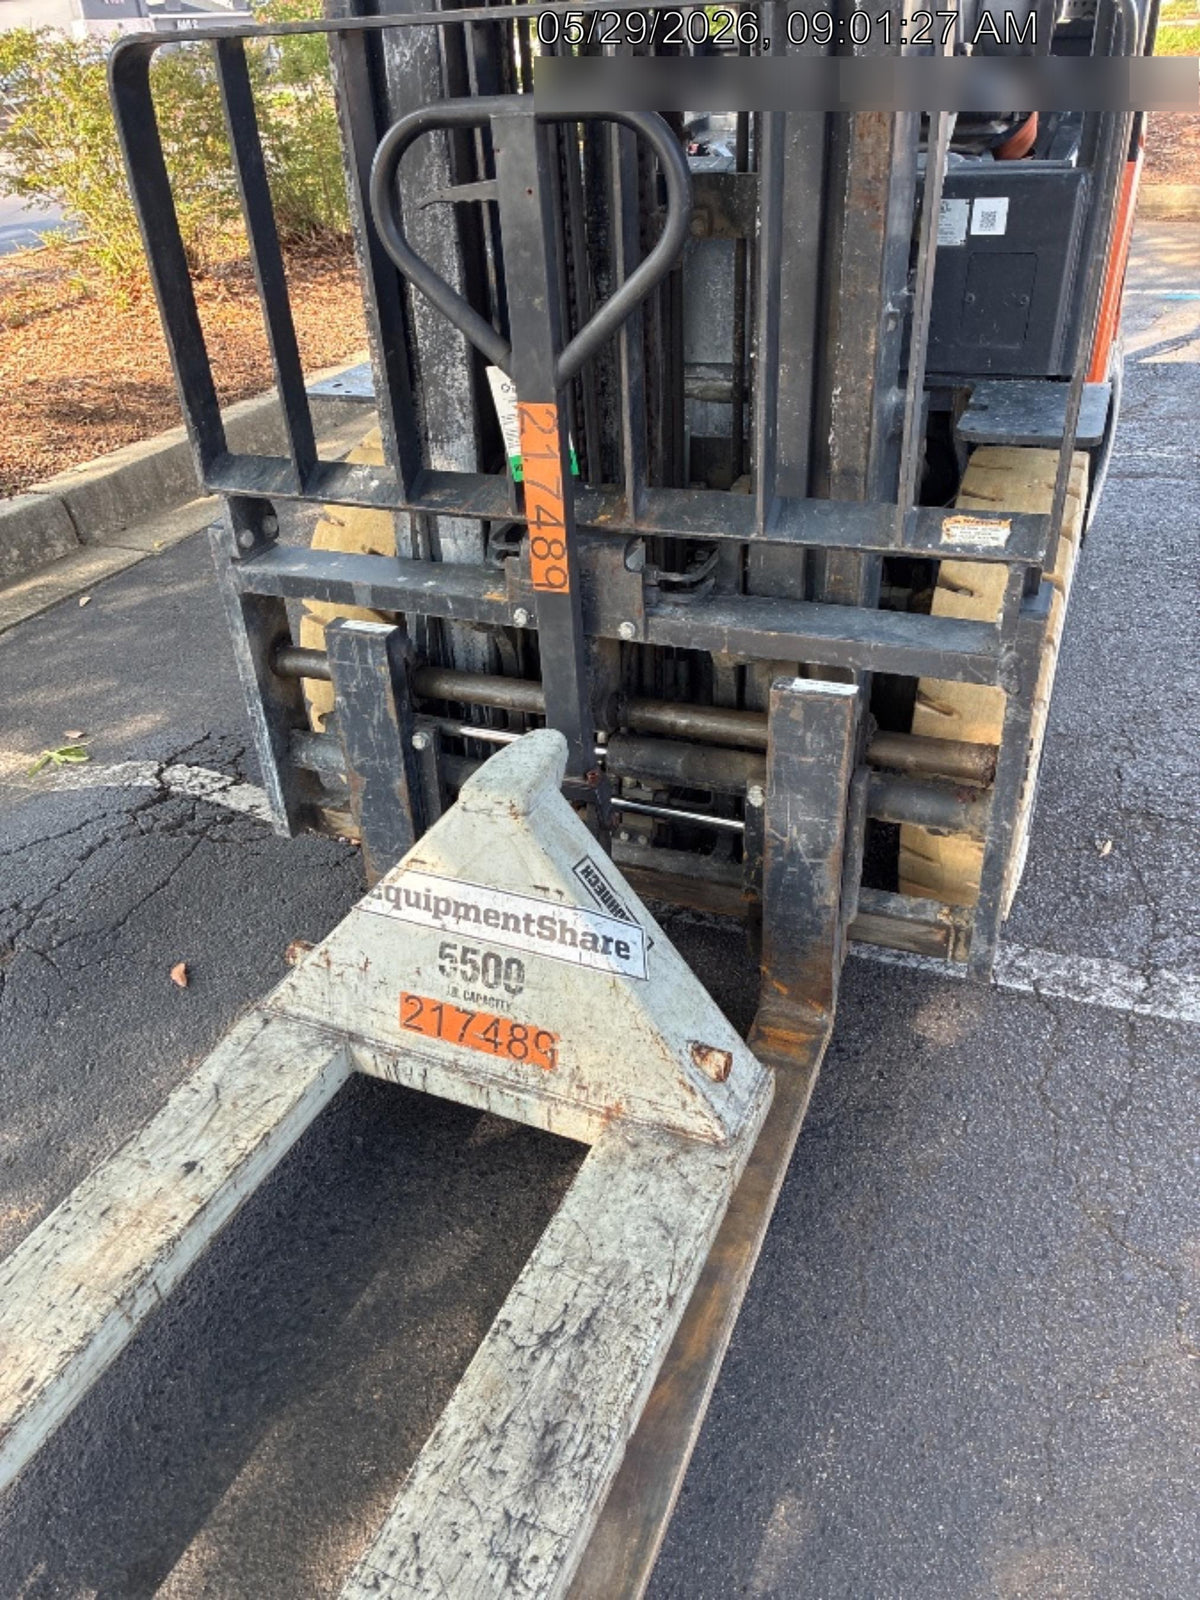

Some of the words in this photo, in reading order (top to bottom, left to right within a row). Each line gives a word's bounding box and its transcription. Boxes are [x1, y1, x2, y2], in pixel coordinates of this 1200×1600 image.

[519, 406, 568, 589] 217489
[439, 941, 525, 995] 5500
[404, 995, 556, 1069] 217489
